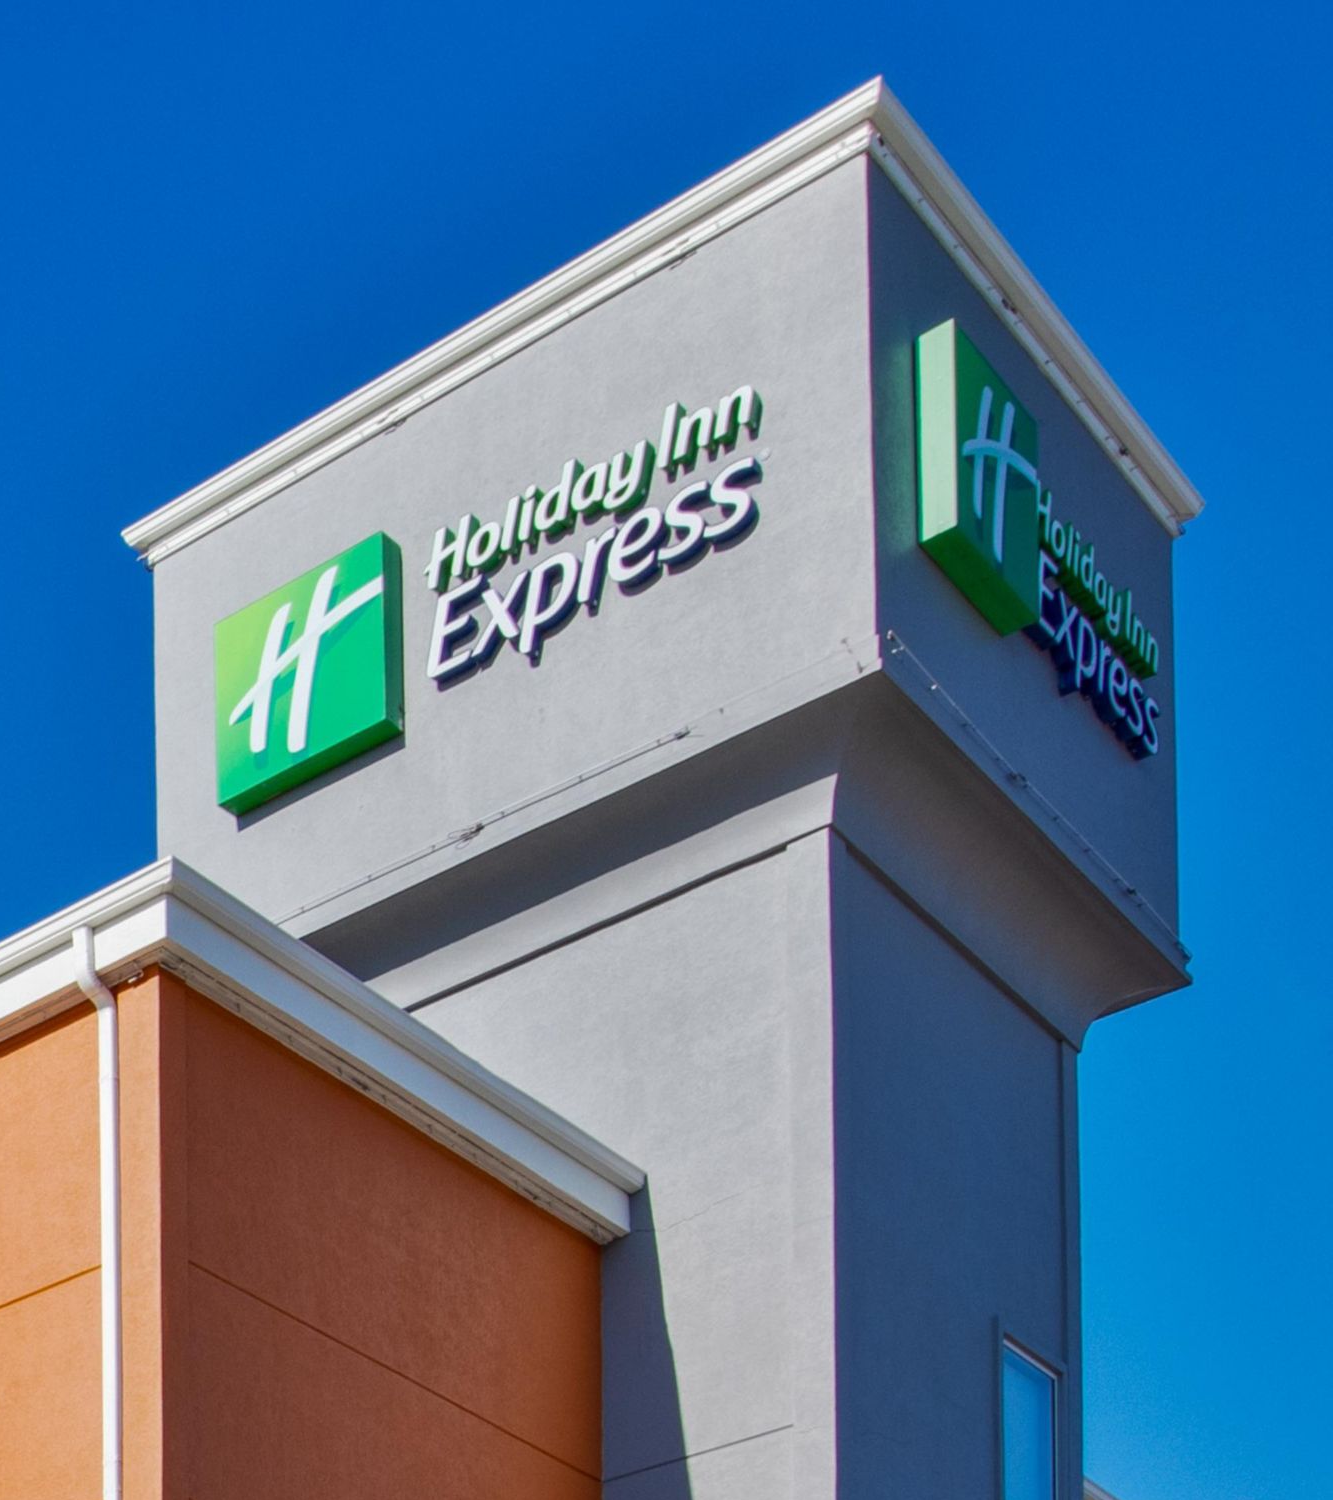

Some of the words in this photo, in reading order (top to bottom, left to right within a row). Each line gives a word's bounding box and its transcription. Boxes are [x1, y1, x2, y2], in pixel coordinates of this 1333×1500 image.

[423, 438, 651, 592] Holiday
[657, 384, 760, 472] Inn
[427, 456, 760, 682] Express
[1036, 477, 1122, 637] Holiday
[1125, 588, 1160, 676] Inn
[1038, 548, 1161, 756] Express
